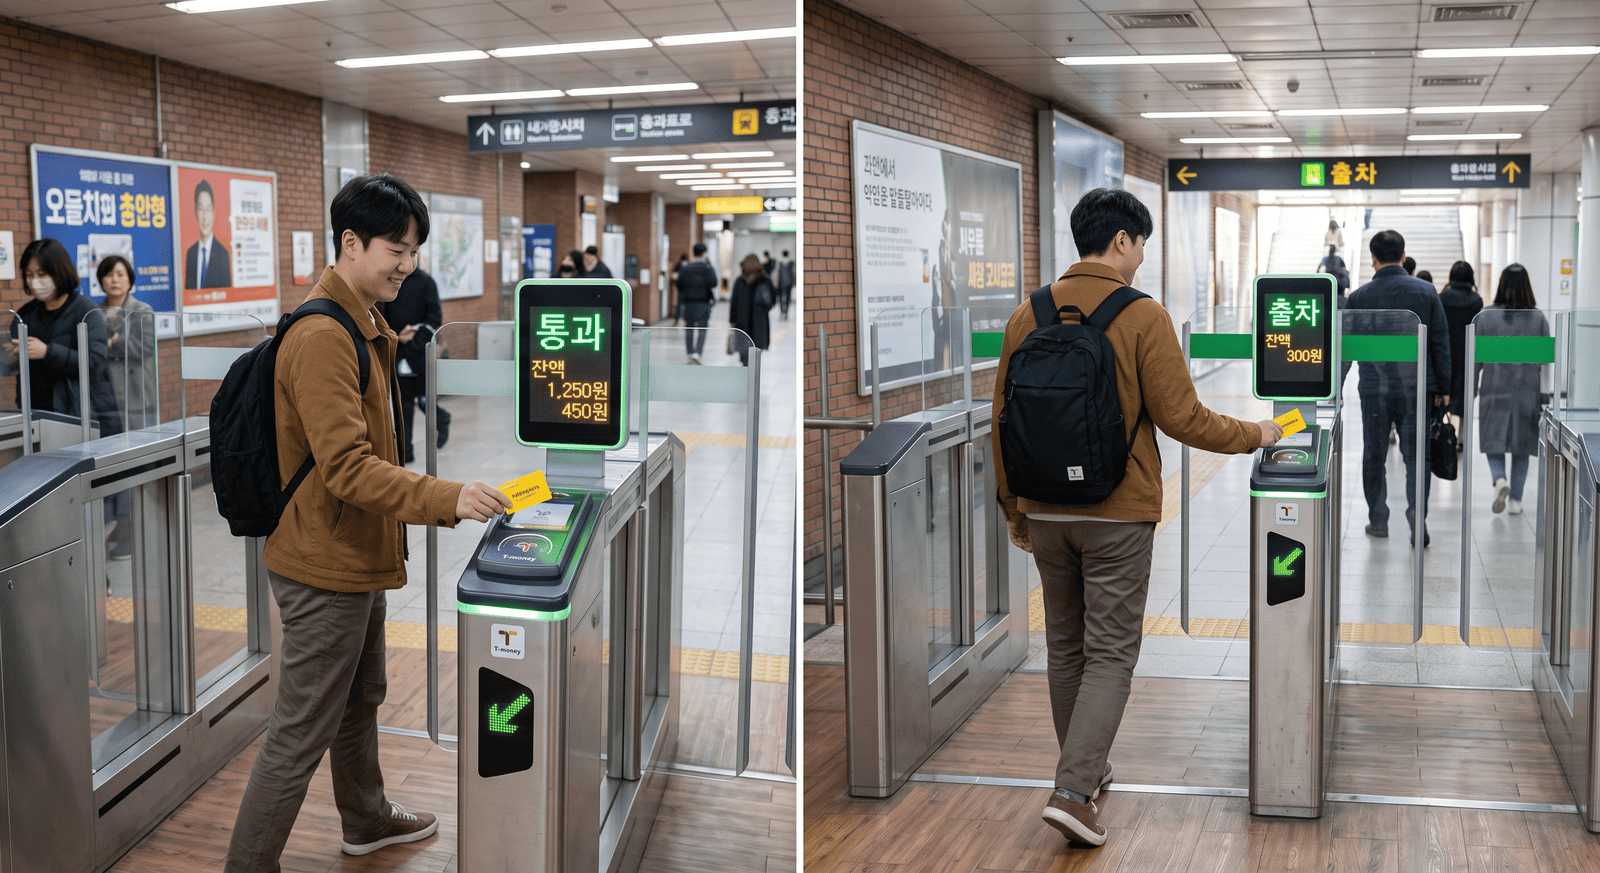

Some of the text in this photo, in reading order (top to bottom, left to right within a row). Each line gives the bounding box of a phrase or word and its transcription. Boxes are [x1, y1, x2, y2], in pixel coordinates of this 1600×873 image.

[1268, 297, 1321, 328] 출차
[536, 313, 605, 352] 통과
[1265, 333, 1292, 349] 잔액
[1286, 348, 1323, 364] 300원
[531, 359, 566, 380] 잔액
[547, 381, 608, 401] 1,250원
[561, 402, 608, 422] 450원
[502, 553, 537, 563] T-money
[493, 645, 522, 656] T-money
